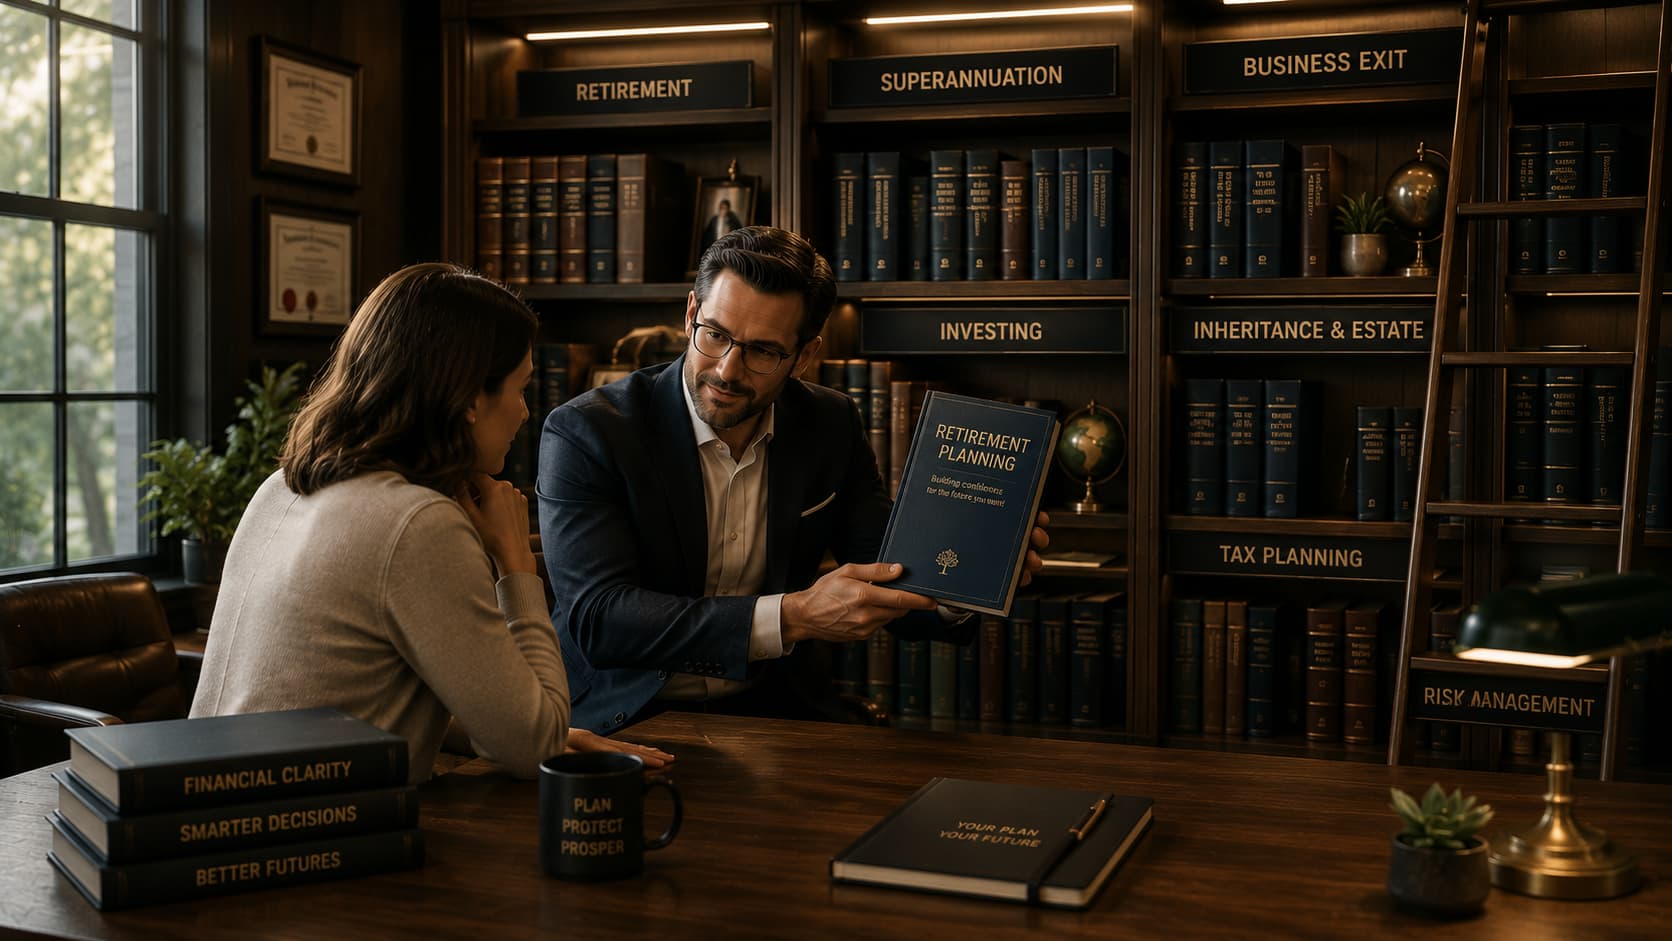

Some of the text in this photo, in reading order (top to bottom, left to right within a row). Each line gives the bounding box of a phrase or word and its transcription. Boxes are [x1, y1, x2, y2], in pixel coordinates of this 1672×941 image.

[1243, 49, 1408, 77] BUSINESS EXIT
[576, 79, 692, 101] RETIREMENT
[881, 65, 1063, 93] SUPERANNUATION
[941, 321, 1042, 341] INVESTING
[1194, 319, 1424, 340] INHERITANCE & ESTATE
[936, 424, 1031, 453] RETIREMENT
[939, 444, 1016, 472] PLANNING
[1219, 545, 1364, 568] TAX PLANNING
[1424, 688, 1465, 707] RISK
[184, 761, 352, 795] FINANCIAL CLARITY
[574, 797, 611, 812] PLAN
[179, 804, 358, 843] SMARTER DECISIONS
[562, 818, 623, 835] PROTECT
[958, 822, 1039, 836] YOUR PLAN
[561, 841, 624, 856] PROSPER
[939, 830, 1041, 847] YOUR FUTURE
[195, 852, 341, 887] BETTER FUTURES
